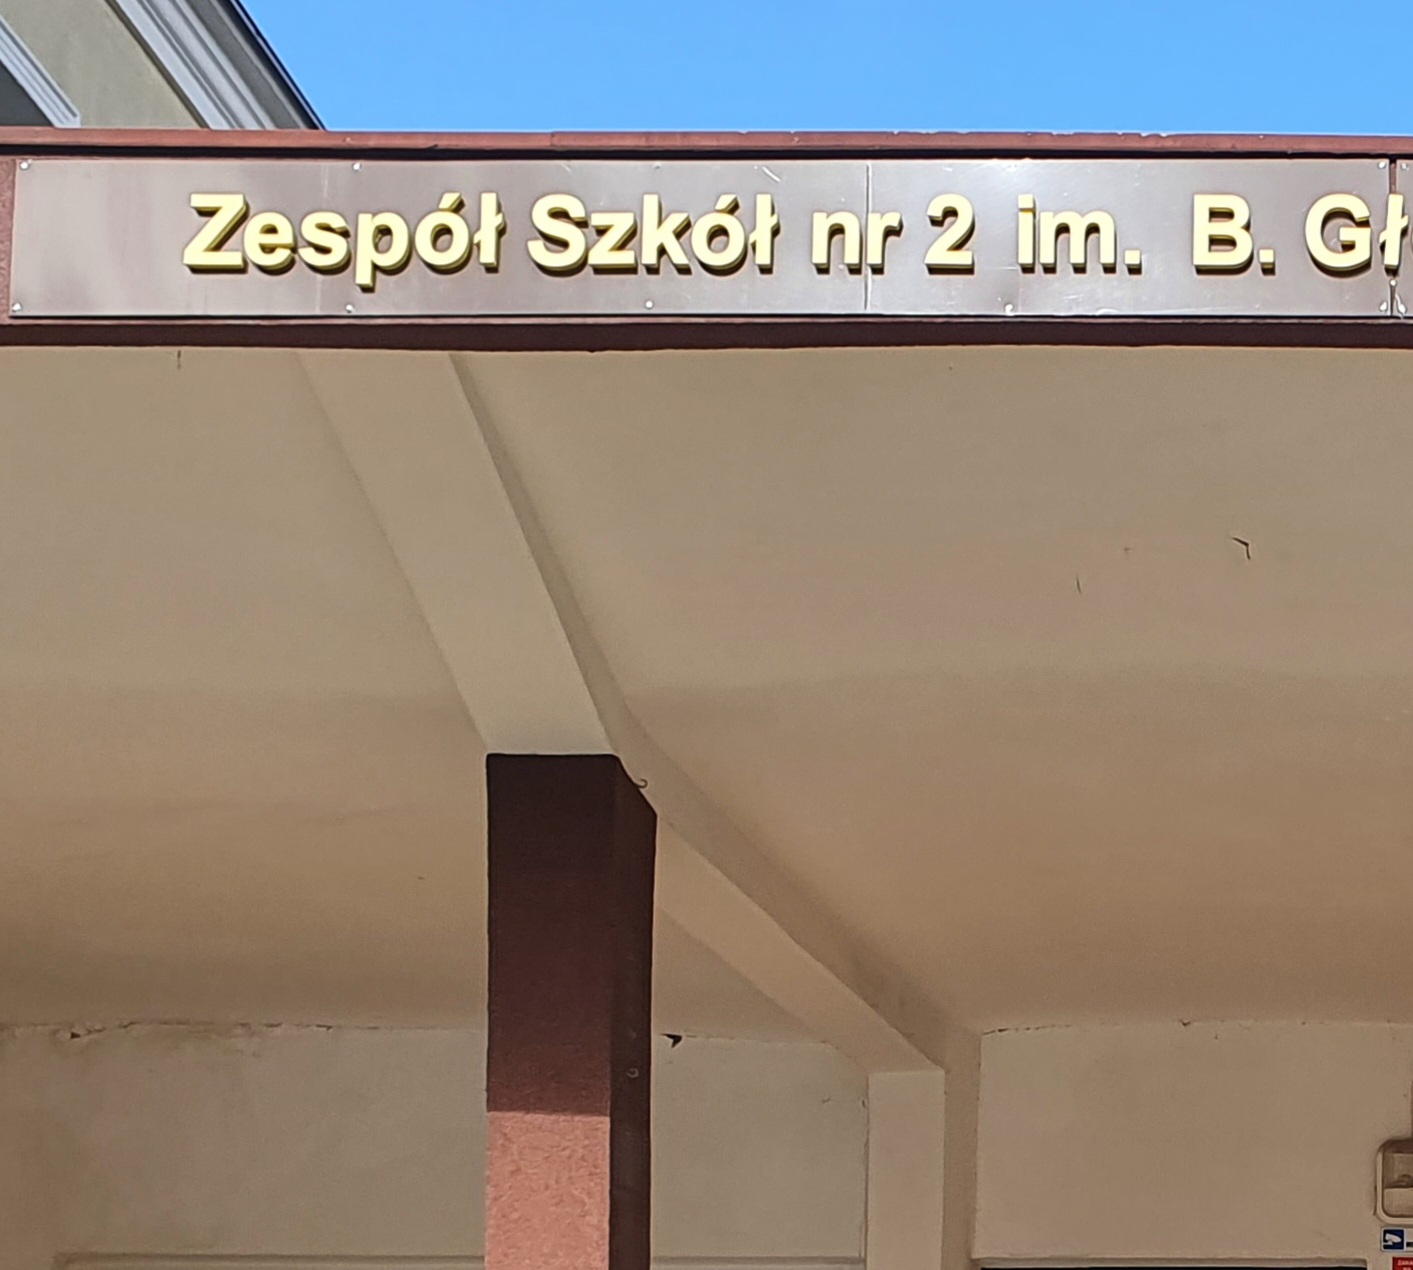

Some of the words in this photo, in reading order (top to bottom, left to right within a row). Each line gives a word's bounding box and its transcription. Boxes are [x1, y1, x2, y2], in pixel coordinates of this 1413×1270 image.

[183, 192, 505, 291] Zespół
[527, 193, 780, 277] Szkół
[811, 210, 901, 275] nr
[924, 193, 975, 275] 2
[1018, 194, 1142, 275] im.
[1193, 194, 1276, 275] B.
